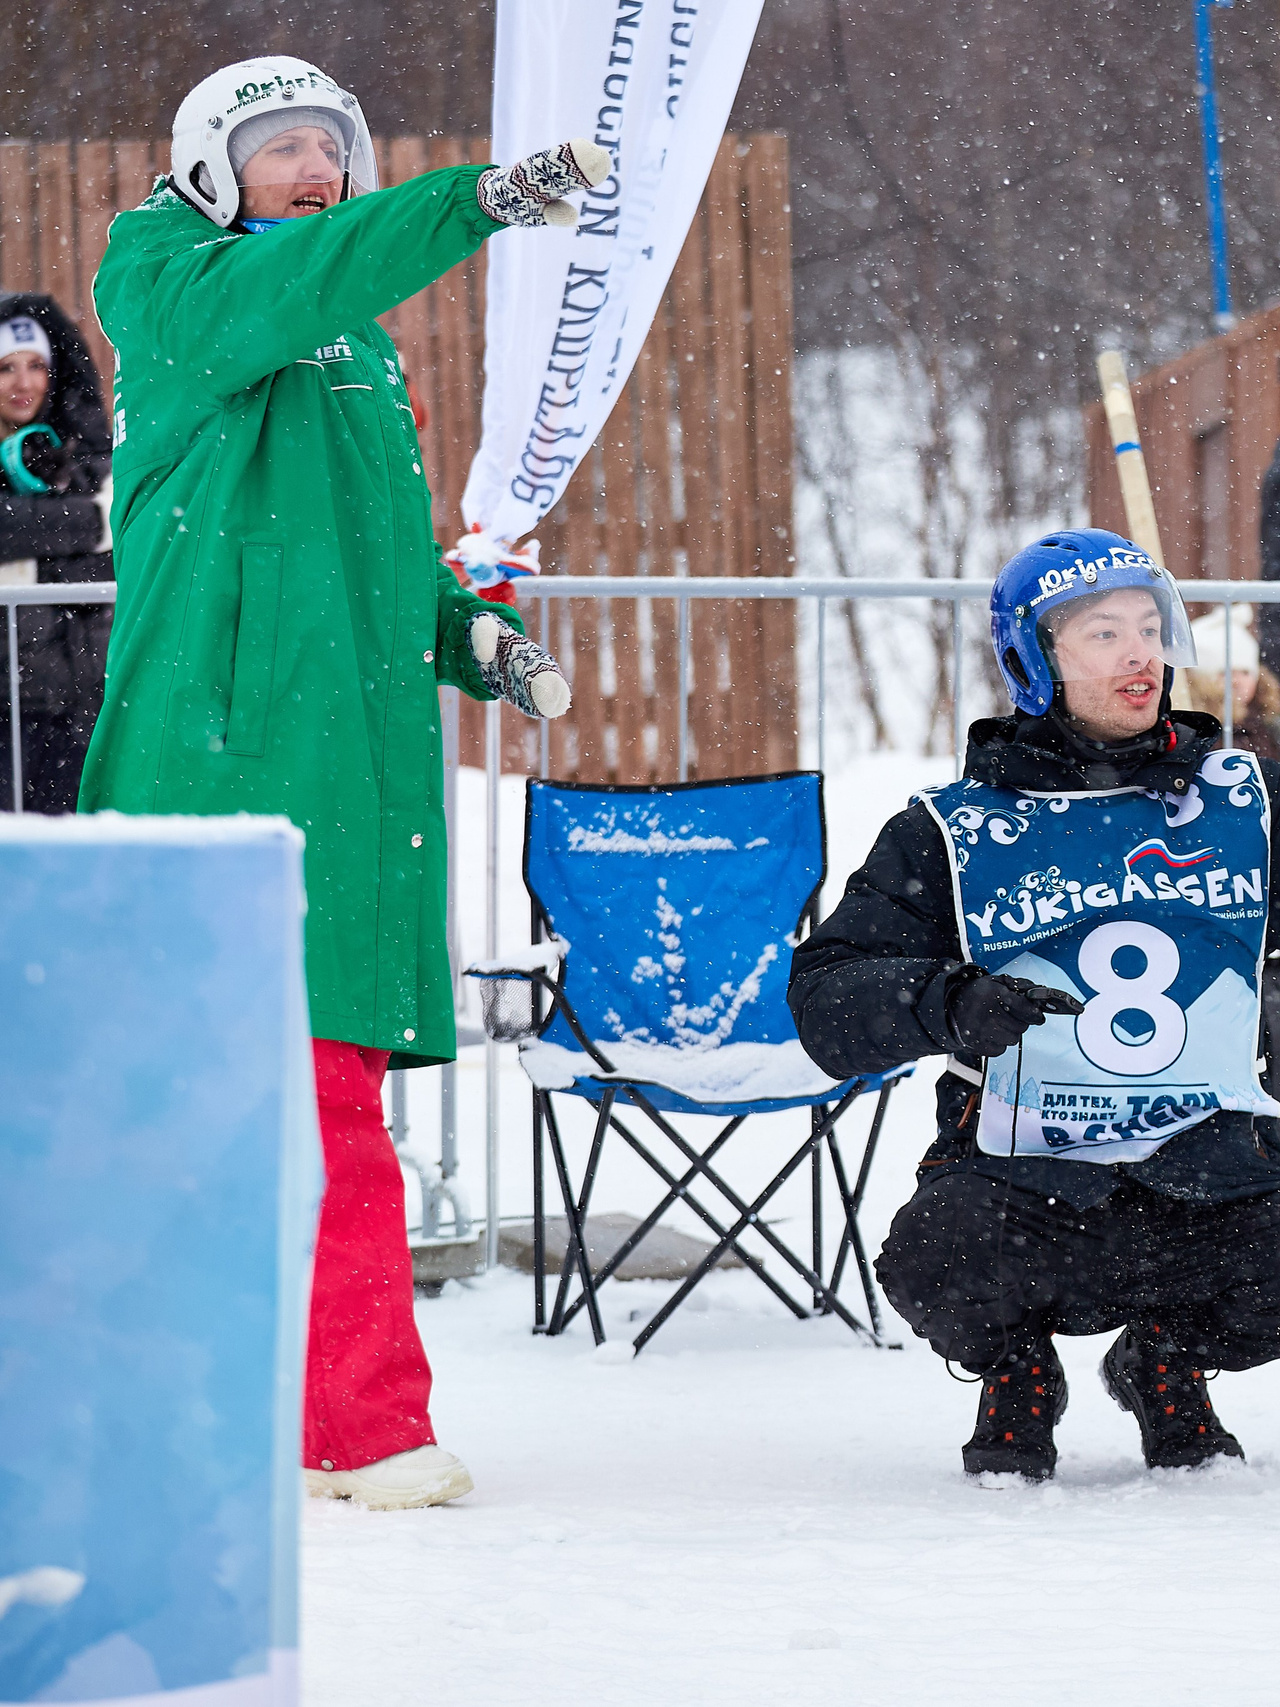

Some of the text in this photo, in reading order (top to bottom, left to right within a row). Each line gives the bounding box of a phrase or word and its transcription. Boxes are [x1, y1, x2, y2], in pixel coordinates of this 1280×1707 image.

[226, 92, 272, 115] МУРМАНСК
[1074, 920, 1187, 1077] 8
[1043, 1093, 1118, 1110] ДЛЯ ТЕХ,
[1041, 1109, 1117, 1122] КТО ЗНАЕТ
[1041, 1126, 1077, 1148] В
